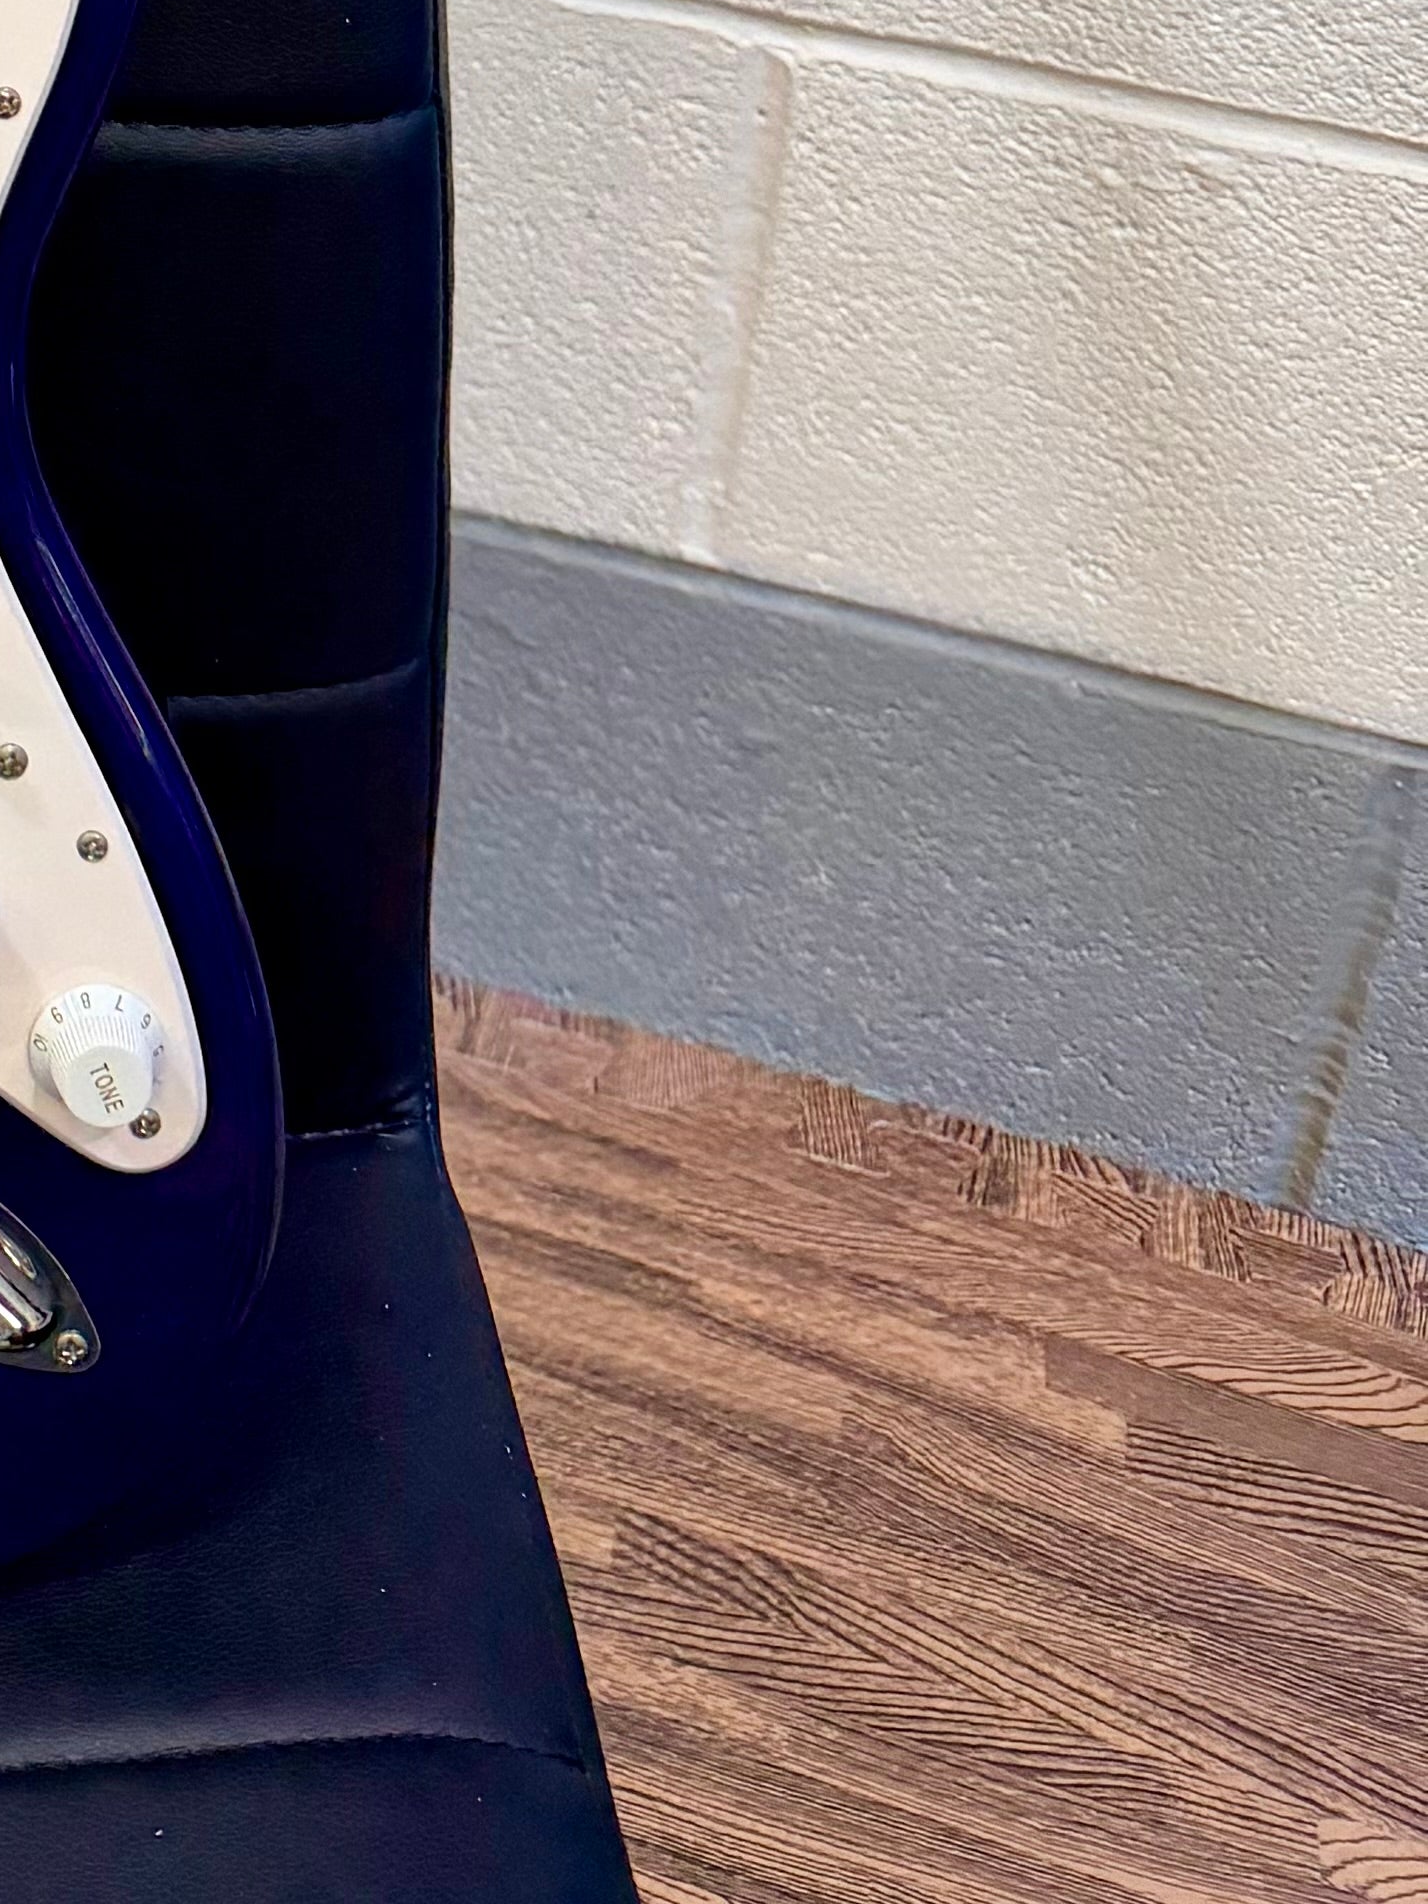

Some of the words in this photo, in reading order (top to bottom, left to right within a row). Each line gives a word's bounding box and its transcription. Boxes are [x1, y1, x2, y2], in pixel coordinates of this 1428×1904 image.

[32, 1033, 48, 1052] 10
[50, 1006, 64, 1024] 9
[80, 991, 91, 1009] 8
[114, 994, 124, 1012] 7
[140, 1012, 152, 1029] 6
[89, 1061, 125, 1114] TONE
